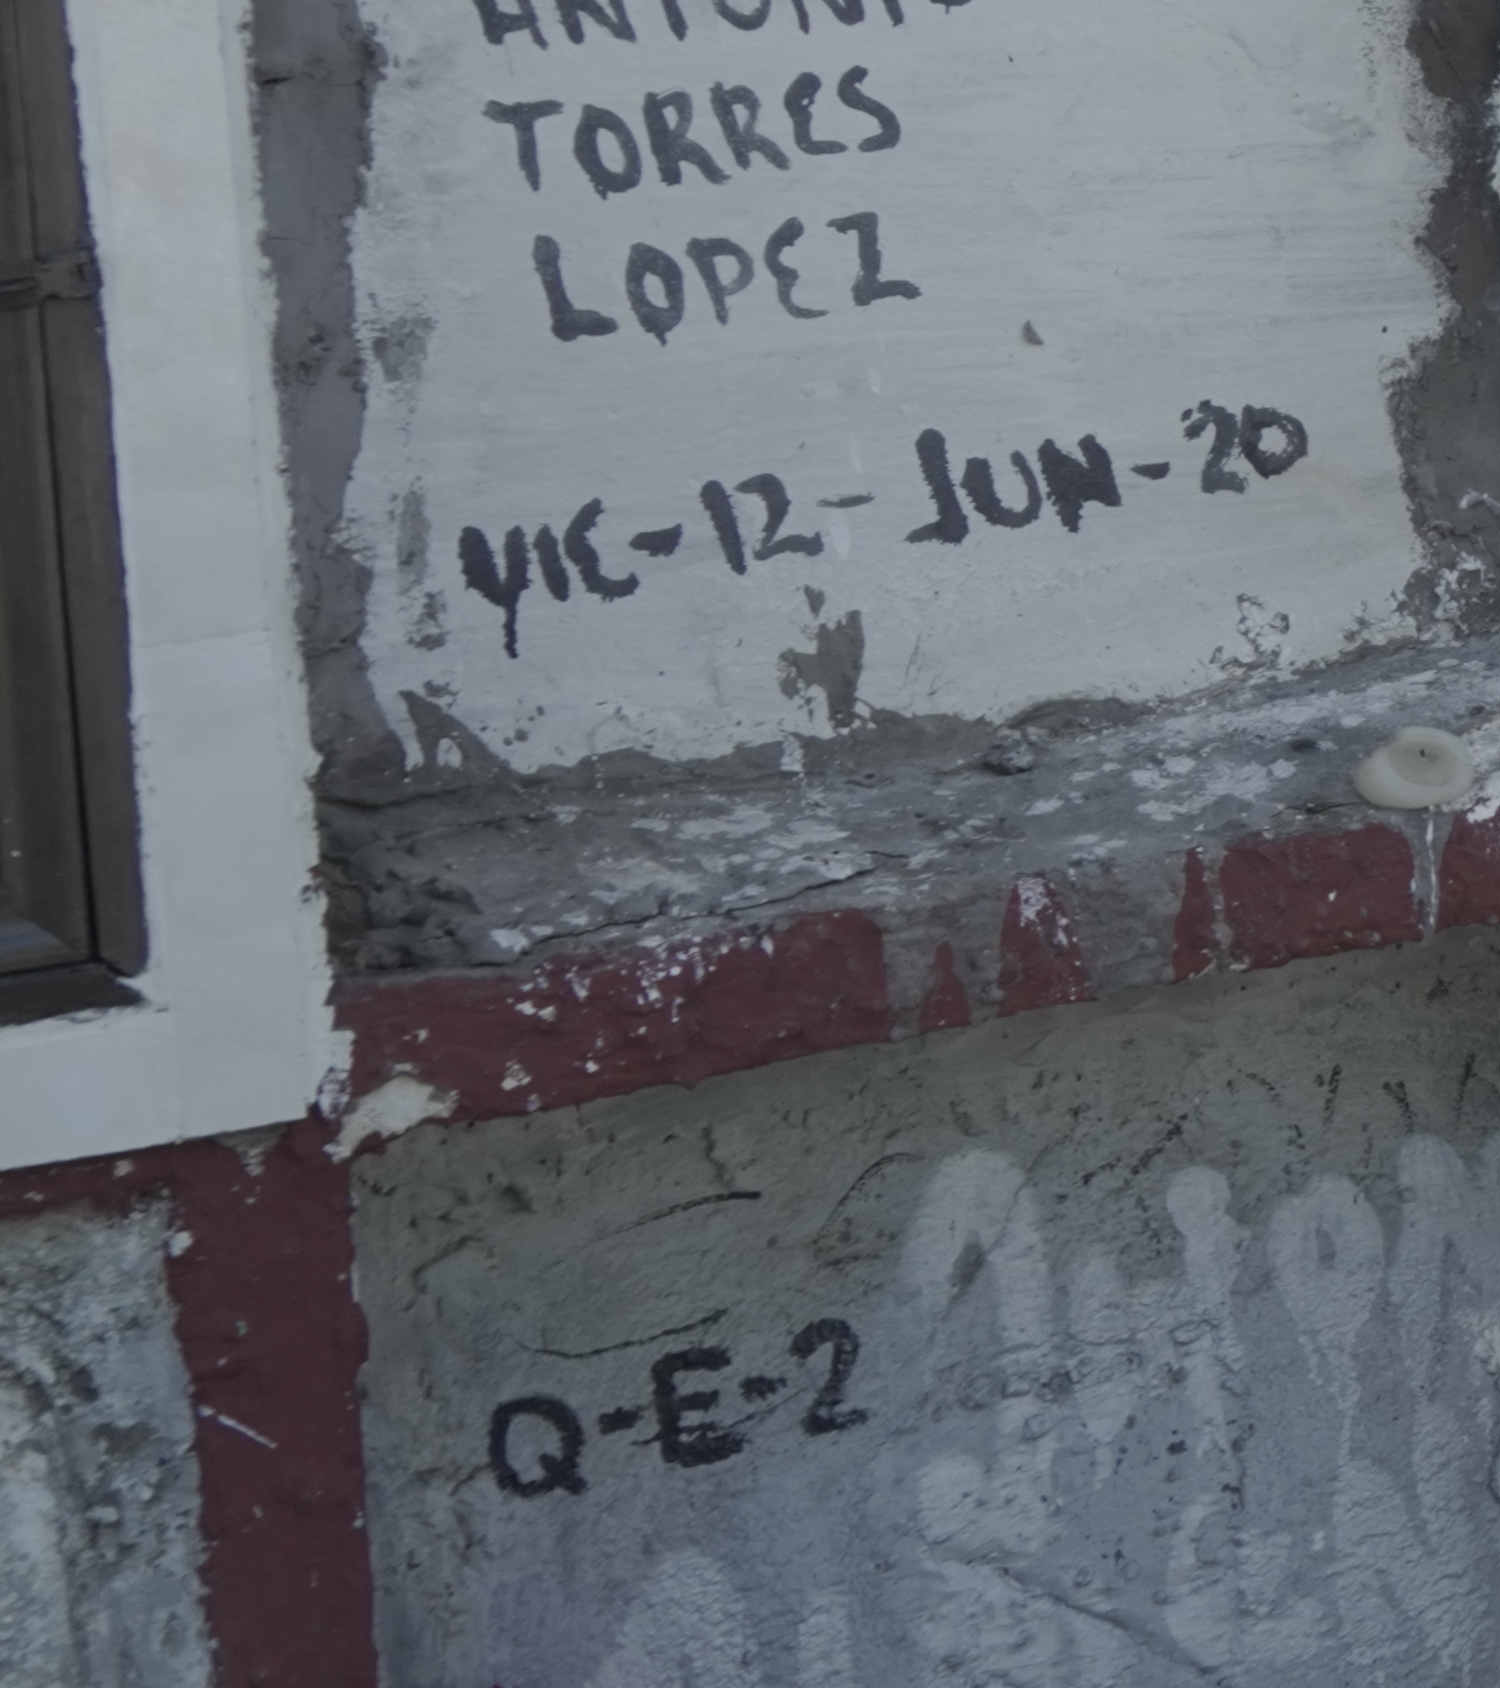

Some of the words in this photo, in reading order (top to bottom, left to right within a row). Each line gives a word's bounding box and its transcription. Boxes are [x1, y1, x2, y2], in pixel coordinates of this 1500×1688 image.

[483, 65, 902, 201] TORRES
[531, 210, 923, 346] LOPEZ
[488, 1318, 871, 1500] Q-E-2
